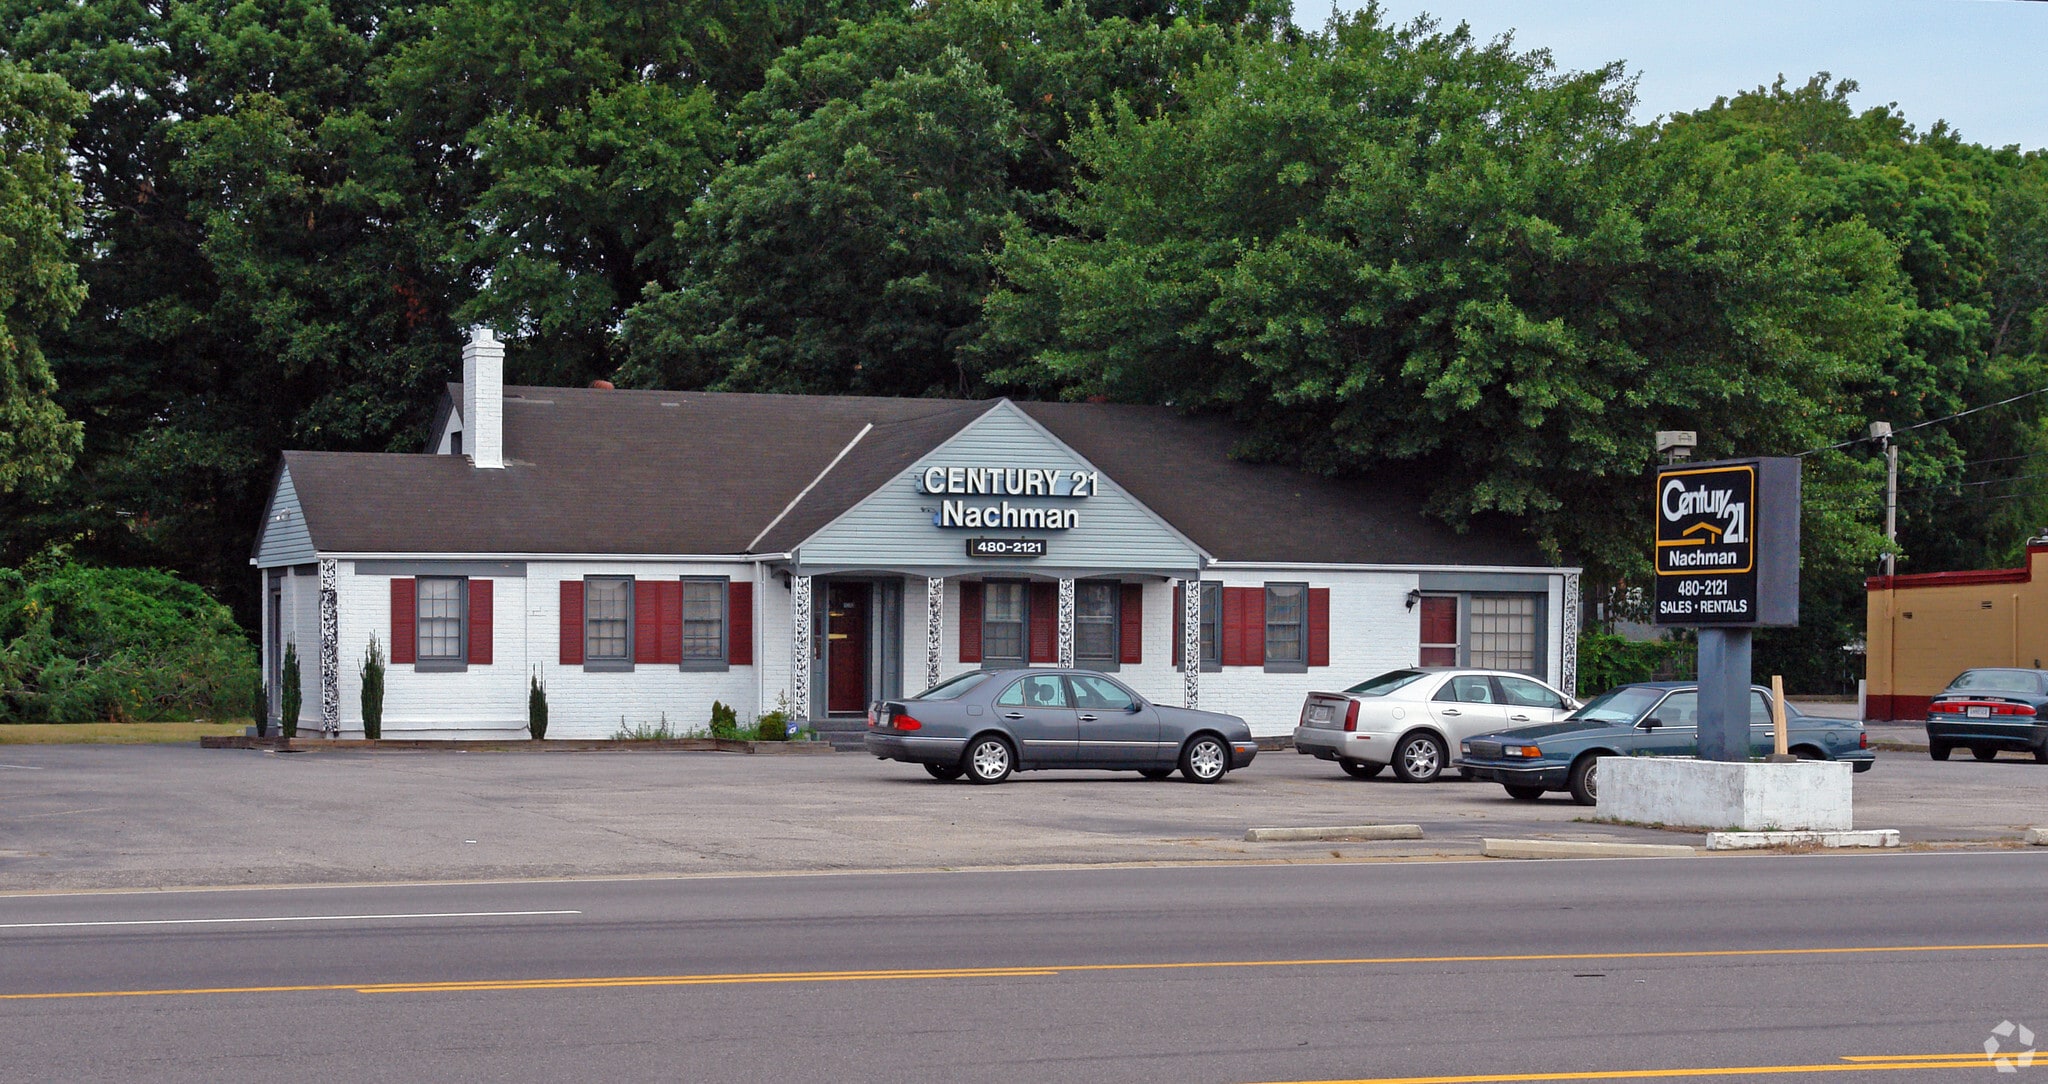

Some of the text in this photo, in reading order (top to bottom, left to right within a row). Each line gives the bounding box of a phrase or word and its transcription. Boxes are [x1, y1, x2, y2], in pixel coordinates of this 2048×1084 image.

[924, 466, 1098, 496] CENTURY 21
[1662, 479, 1733, 522] Century
[941, 500, 1079, 529] Nachman
[1723, 502, 1745, 544] 21
[977, 542, 1042, 553] 480-2121
[1669, 549, 1737, 567] Nachman
[1678, 579, 1728, 596] 480-2121
[1660, 599, 1748, 614] SALES RENTALS
